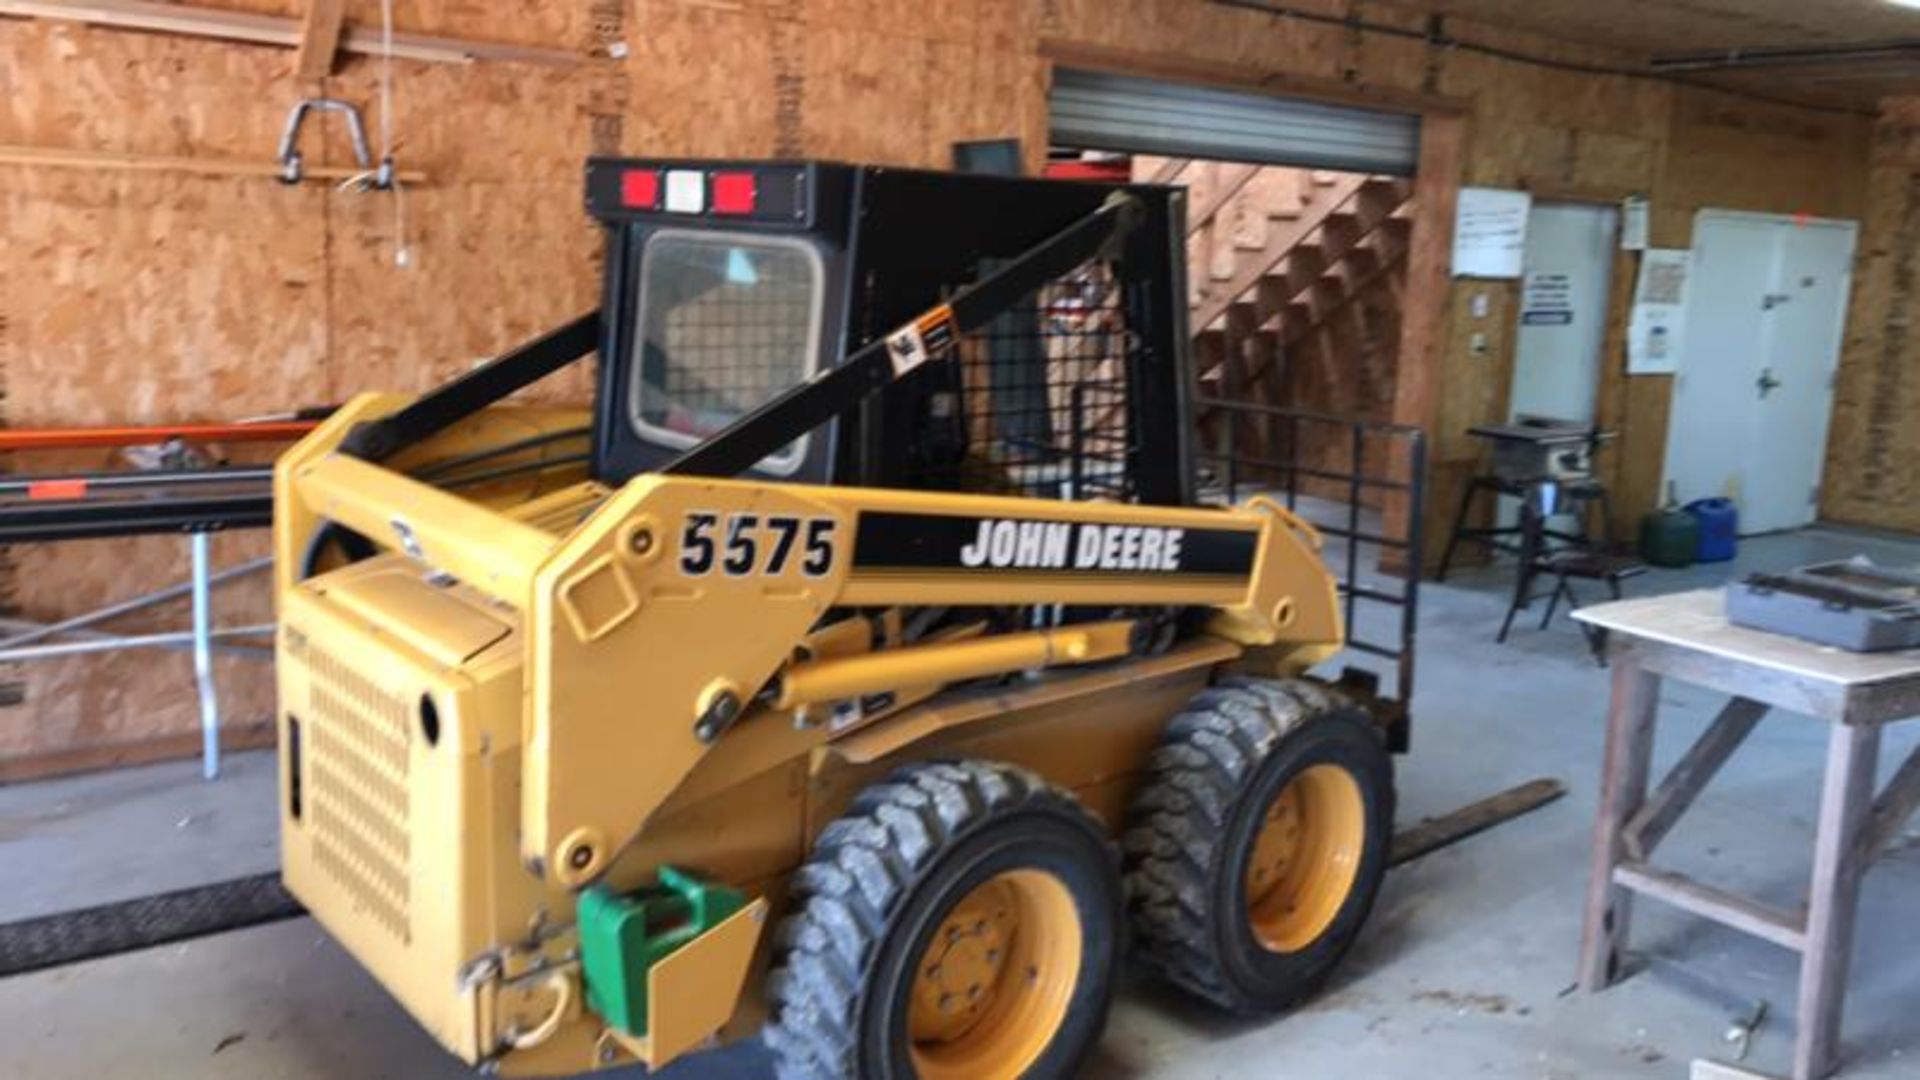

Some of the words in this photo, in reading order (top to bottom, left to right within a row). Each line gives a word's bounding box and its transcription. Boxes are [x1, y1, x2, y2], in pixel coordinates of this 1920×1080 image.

[680, 512, 836, 577] 5575
[960, 519, 1072, 568] JOHN
[1074, 524, 1185, 571] DEERE
